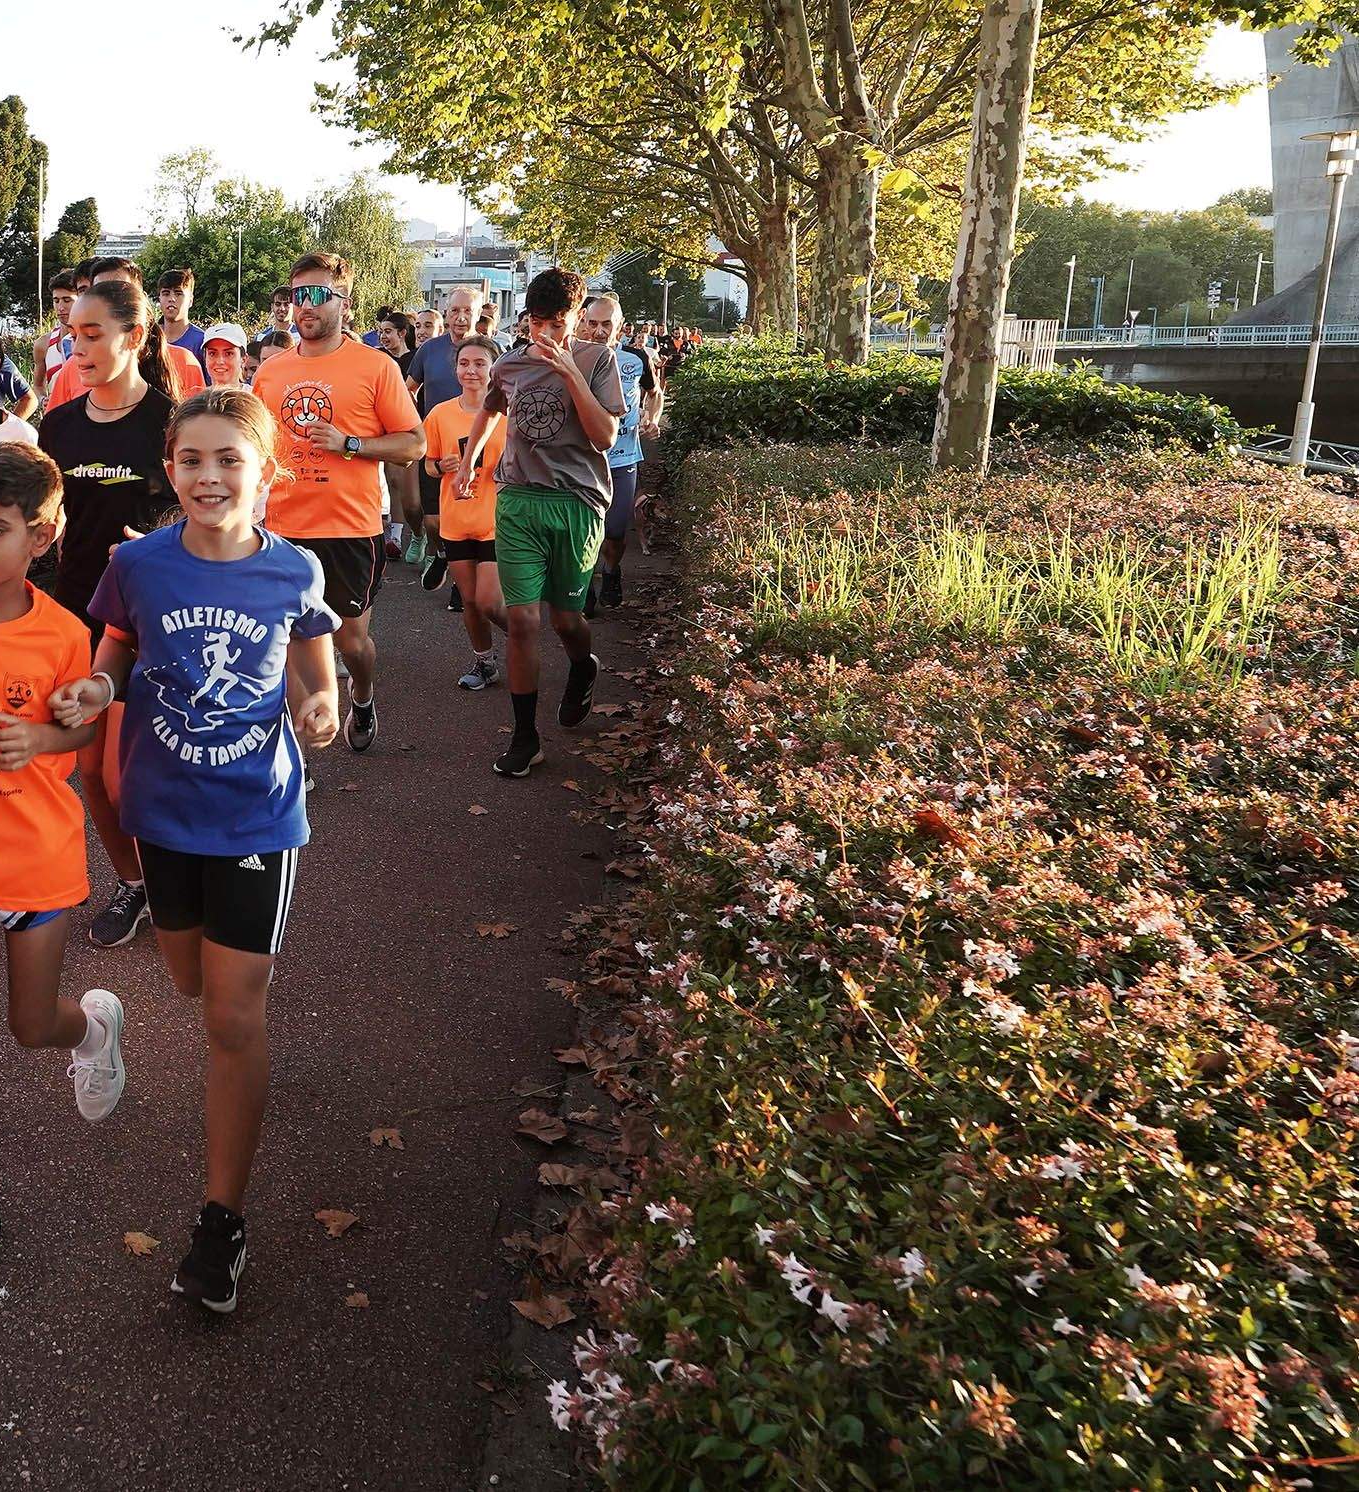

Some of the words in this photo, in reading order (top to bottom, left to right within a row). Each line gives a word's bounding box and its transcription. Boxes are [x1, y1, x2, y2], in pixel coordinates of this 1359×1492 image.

[73, 464, 132, 479] dreamfit
[161, 606, 268, 644] ATLETISMO
[152, 715, 179, 751] ILLA
[180, 742, 204, 764] DE
[208, 724, 267, 767] TAMBO
[238, 861, 266, 871] adidas
